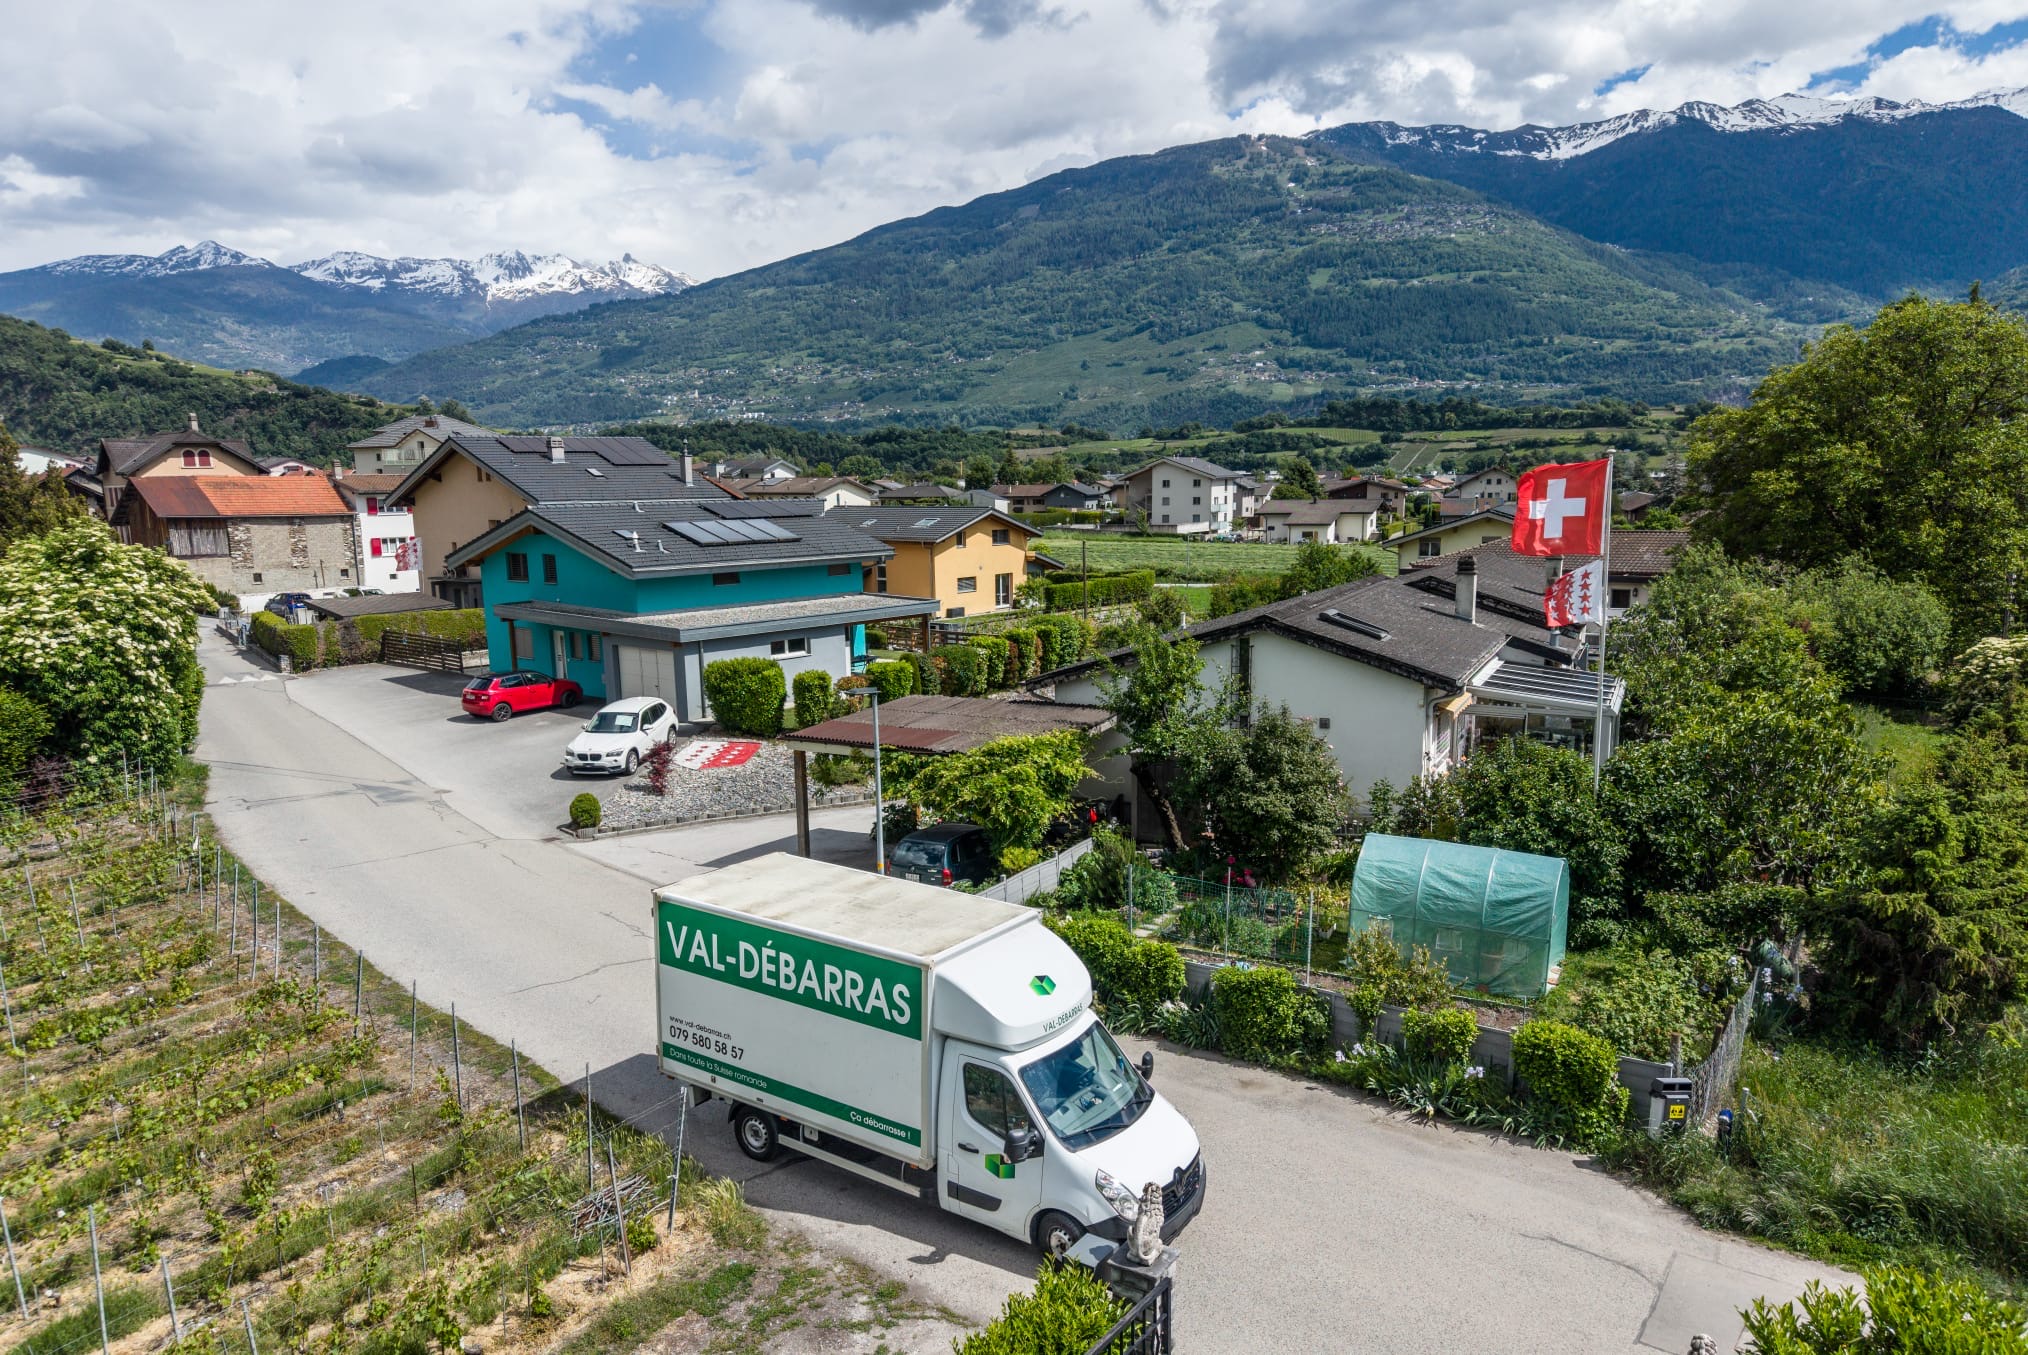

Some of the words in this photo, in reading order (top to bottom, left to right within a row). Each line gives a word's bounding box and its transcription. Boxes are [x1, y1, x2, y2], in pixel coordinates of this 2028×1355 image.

[666, 921, 911, 1025] VAL-DÉBARRAS
[669, 1016, 732, 1040] www.val-debarras.ch
[670, 1025, 688, 1041] 079
[692, 1033, 711, 1049] 580
[714, 1040, 727, 1055] 58
[731, 1046, 744, 1060] 57
[670, 1048, 686, 1061] Dans
[687, 1054, 705, 1067] toute
[706, 1061, 713, 1070] la
[714, 1063, 733, 1077] Suisse
[734, 1072, 767, 1088] romande
[850, 1111, 861, 1122] Ça
[863, 1117, 906, 1137] débarrasse
